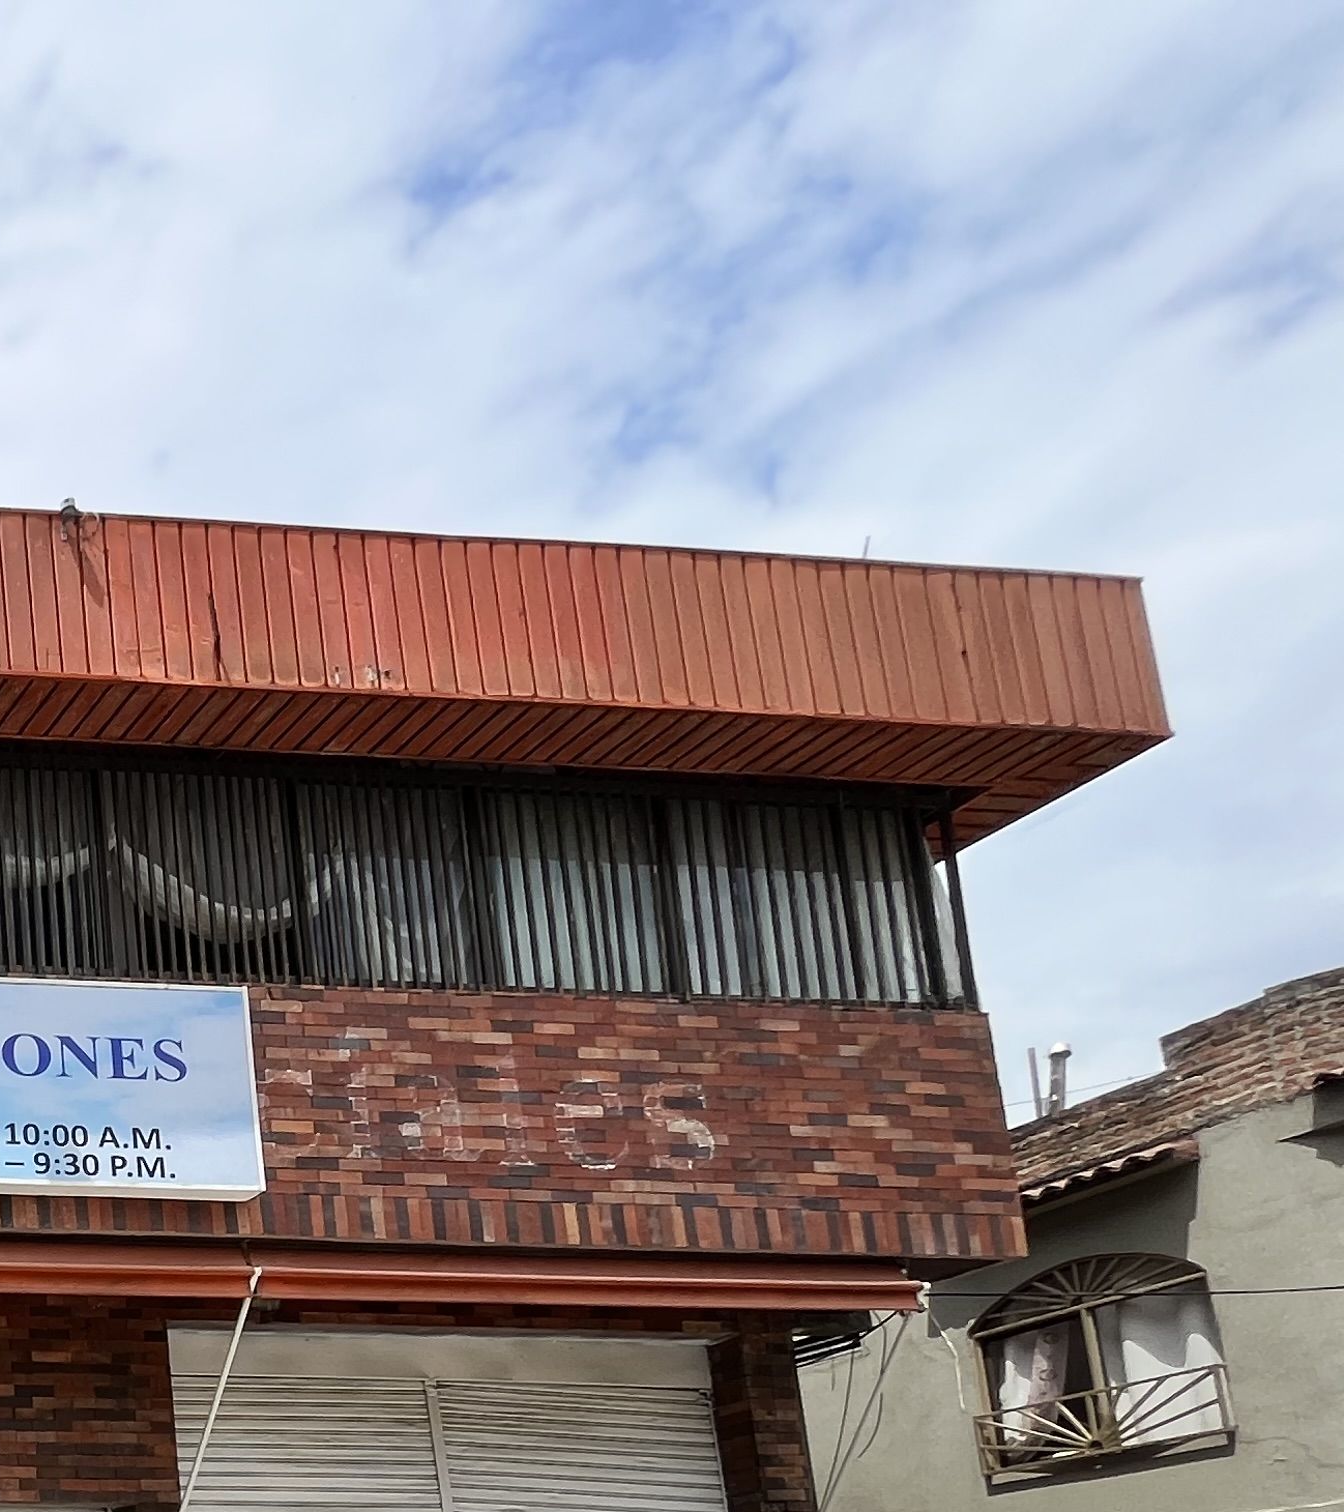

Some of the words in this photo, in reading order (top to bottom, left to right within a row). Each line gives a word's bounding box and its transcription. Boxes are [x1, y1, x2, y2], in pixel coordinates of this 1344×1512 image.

[4, 1122, 89, 1149] 10:00
[98, 1126, 173, 1151] A.M.
[33, 1151, 101, 1178] 9:30
[110, 1154, 177, 1180] P.M.
